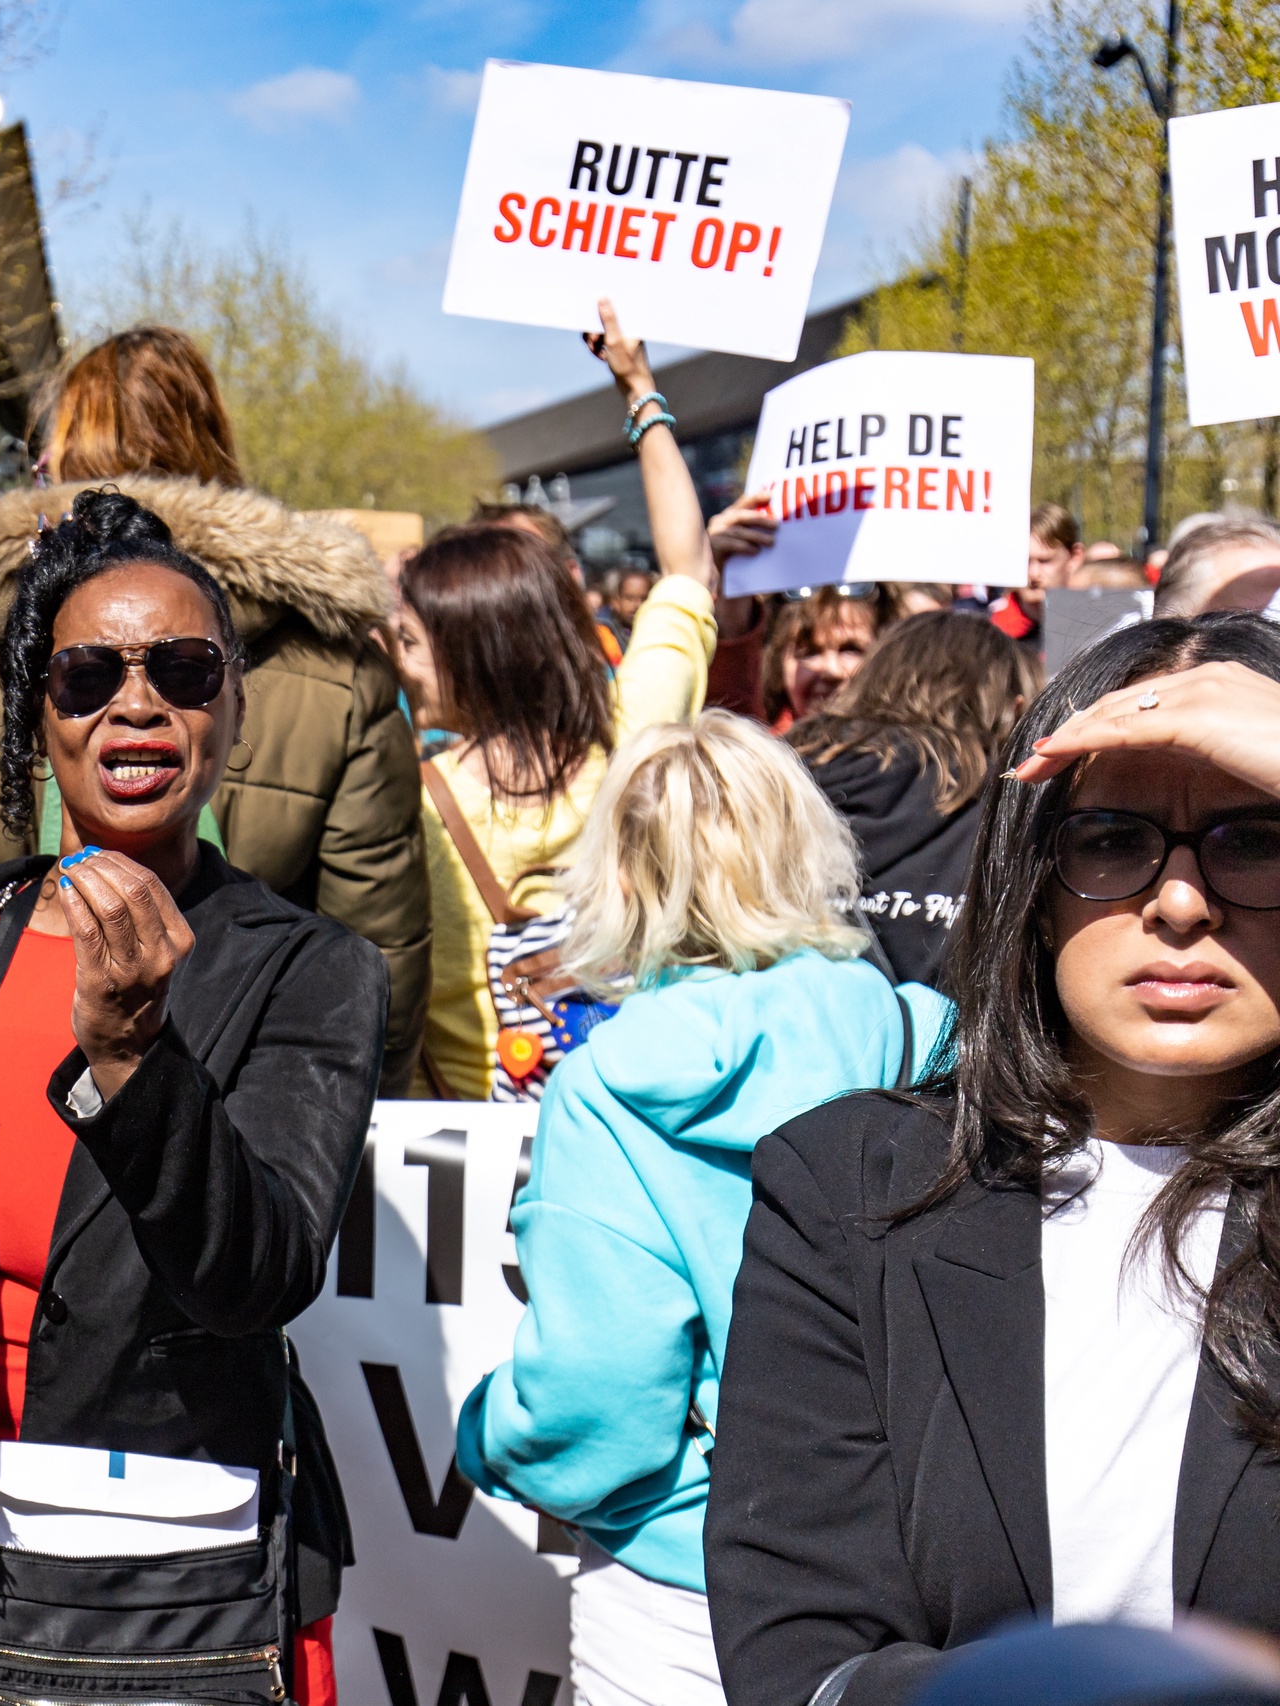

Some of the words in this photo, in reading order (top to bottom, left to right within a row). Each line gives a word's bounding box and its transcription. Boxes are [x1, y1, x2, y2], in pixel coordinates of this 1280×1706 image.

[569, 138, 730, 208] RUTTE
[493, 192, 677, 262] SCHIET
[691, 217, 782, 277] OP!
[785, 413, 887, 469] HELP
[908, 413, 963, 458] DE
[889, 891, 921, 919] To
